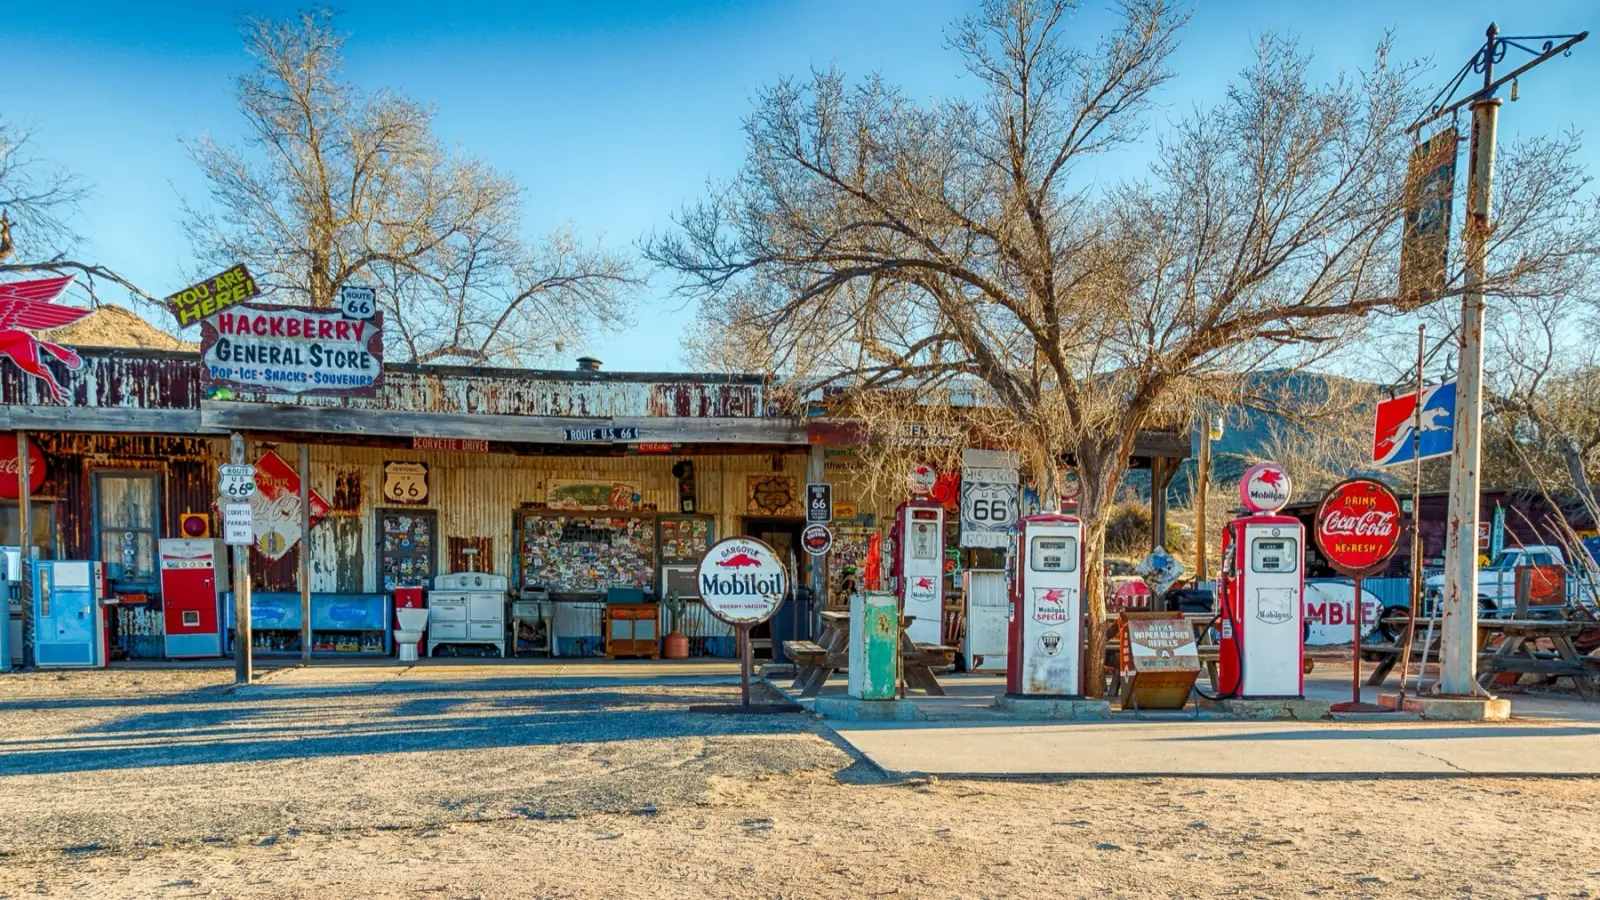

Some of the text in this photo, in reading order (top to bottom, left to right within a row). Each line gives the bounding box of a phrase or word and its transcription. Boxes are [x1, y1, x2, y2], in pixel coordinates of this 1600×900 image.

[172, 267, 246, 307] YOU ARE
[180, 280, 254, 325] HERE!
[346, 292, 371, 300] ROUTE
[348, 301, 370, 314] 66
[218, 313, 365, 342] HACKBERRY
[216, 338, 370, 369] GENERAL STORE
[570, 428, 631, 441] ROUTE U.S. 66
[417, 438, 486, 451] CORVETTE DRIVE
[227, 467, 249, 475] ROUTE
[228, 483, 249, 496] 66
[393, 481, 419, 497] 66
[1250, 490, 1286, 501] Mobilgas
[812, 498, 827, 509] 66
[1345, 497, 1377, 506] DRINK
[973, 499, 1007, 521] 66
[1323, 510, 1397, 537] Coca-Cola
[966, 533, 1007, 545] ROUT
[721, 545, 760, 558] GARGOYLE
[702, 572, 783, 595] Mobiloil
[913, 591, 935, 599] Mobilgas
[1038, 606, 1066, 615] Mobilgas
[1259, 610, 1290, 620] Mobilgas
[1303, 602, 1376, 627] MBLE
[1134, 631, 1190, 639] WIPER BLADES
[1147, 639, 1178, 647] REFILLS
